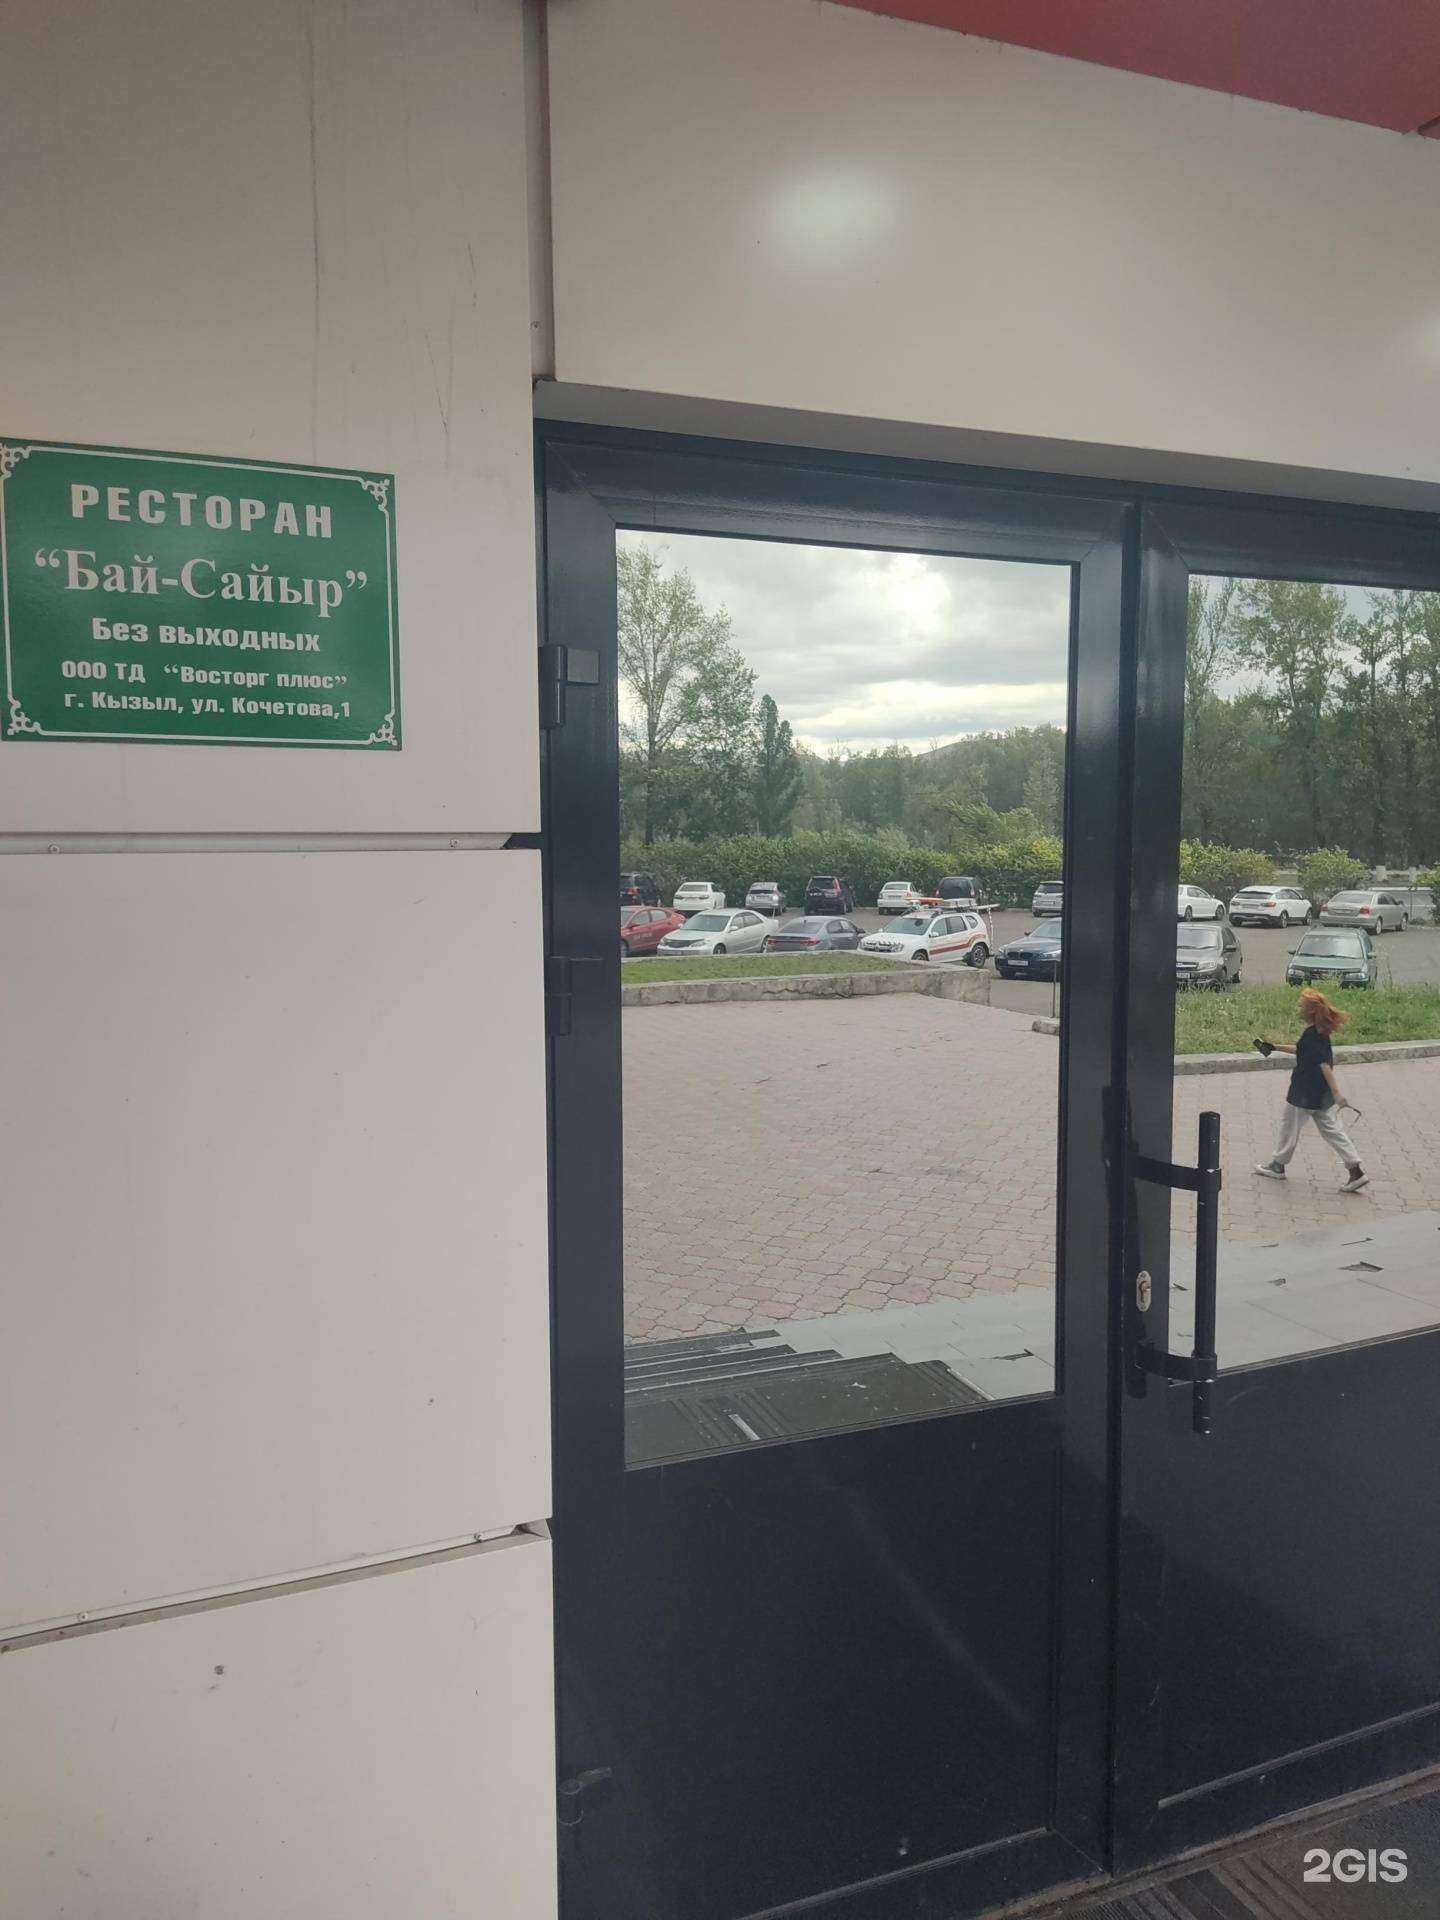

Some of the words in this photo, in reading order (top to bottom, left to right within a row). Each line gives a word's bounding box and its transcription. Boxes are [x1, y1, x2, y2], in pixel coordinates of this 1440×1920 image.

[71, 484, 332, 538] РЕСТОРАН
[35, 549, 367, 618] “Бай-Сайыр”
[92, 617, 149, 642] Без
[159, 625, 320, 652] выходных
[61, 660, 107, 679] ООО
[115, 662, 146, 684] ТД
[163, 664, 270, 688] “Восторг
[277, 674, 348, 689] плюс”
[64, 693, 84, 708] г.
[91, 691, 184, 714] Кызыл,
[192, 699, 225, 715] ул.
